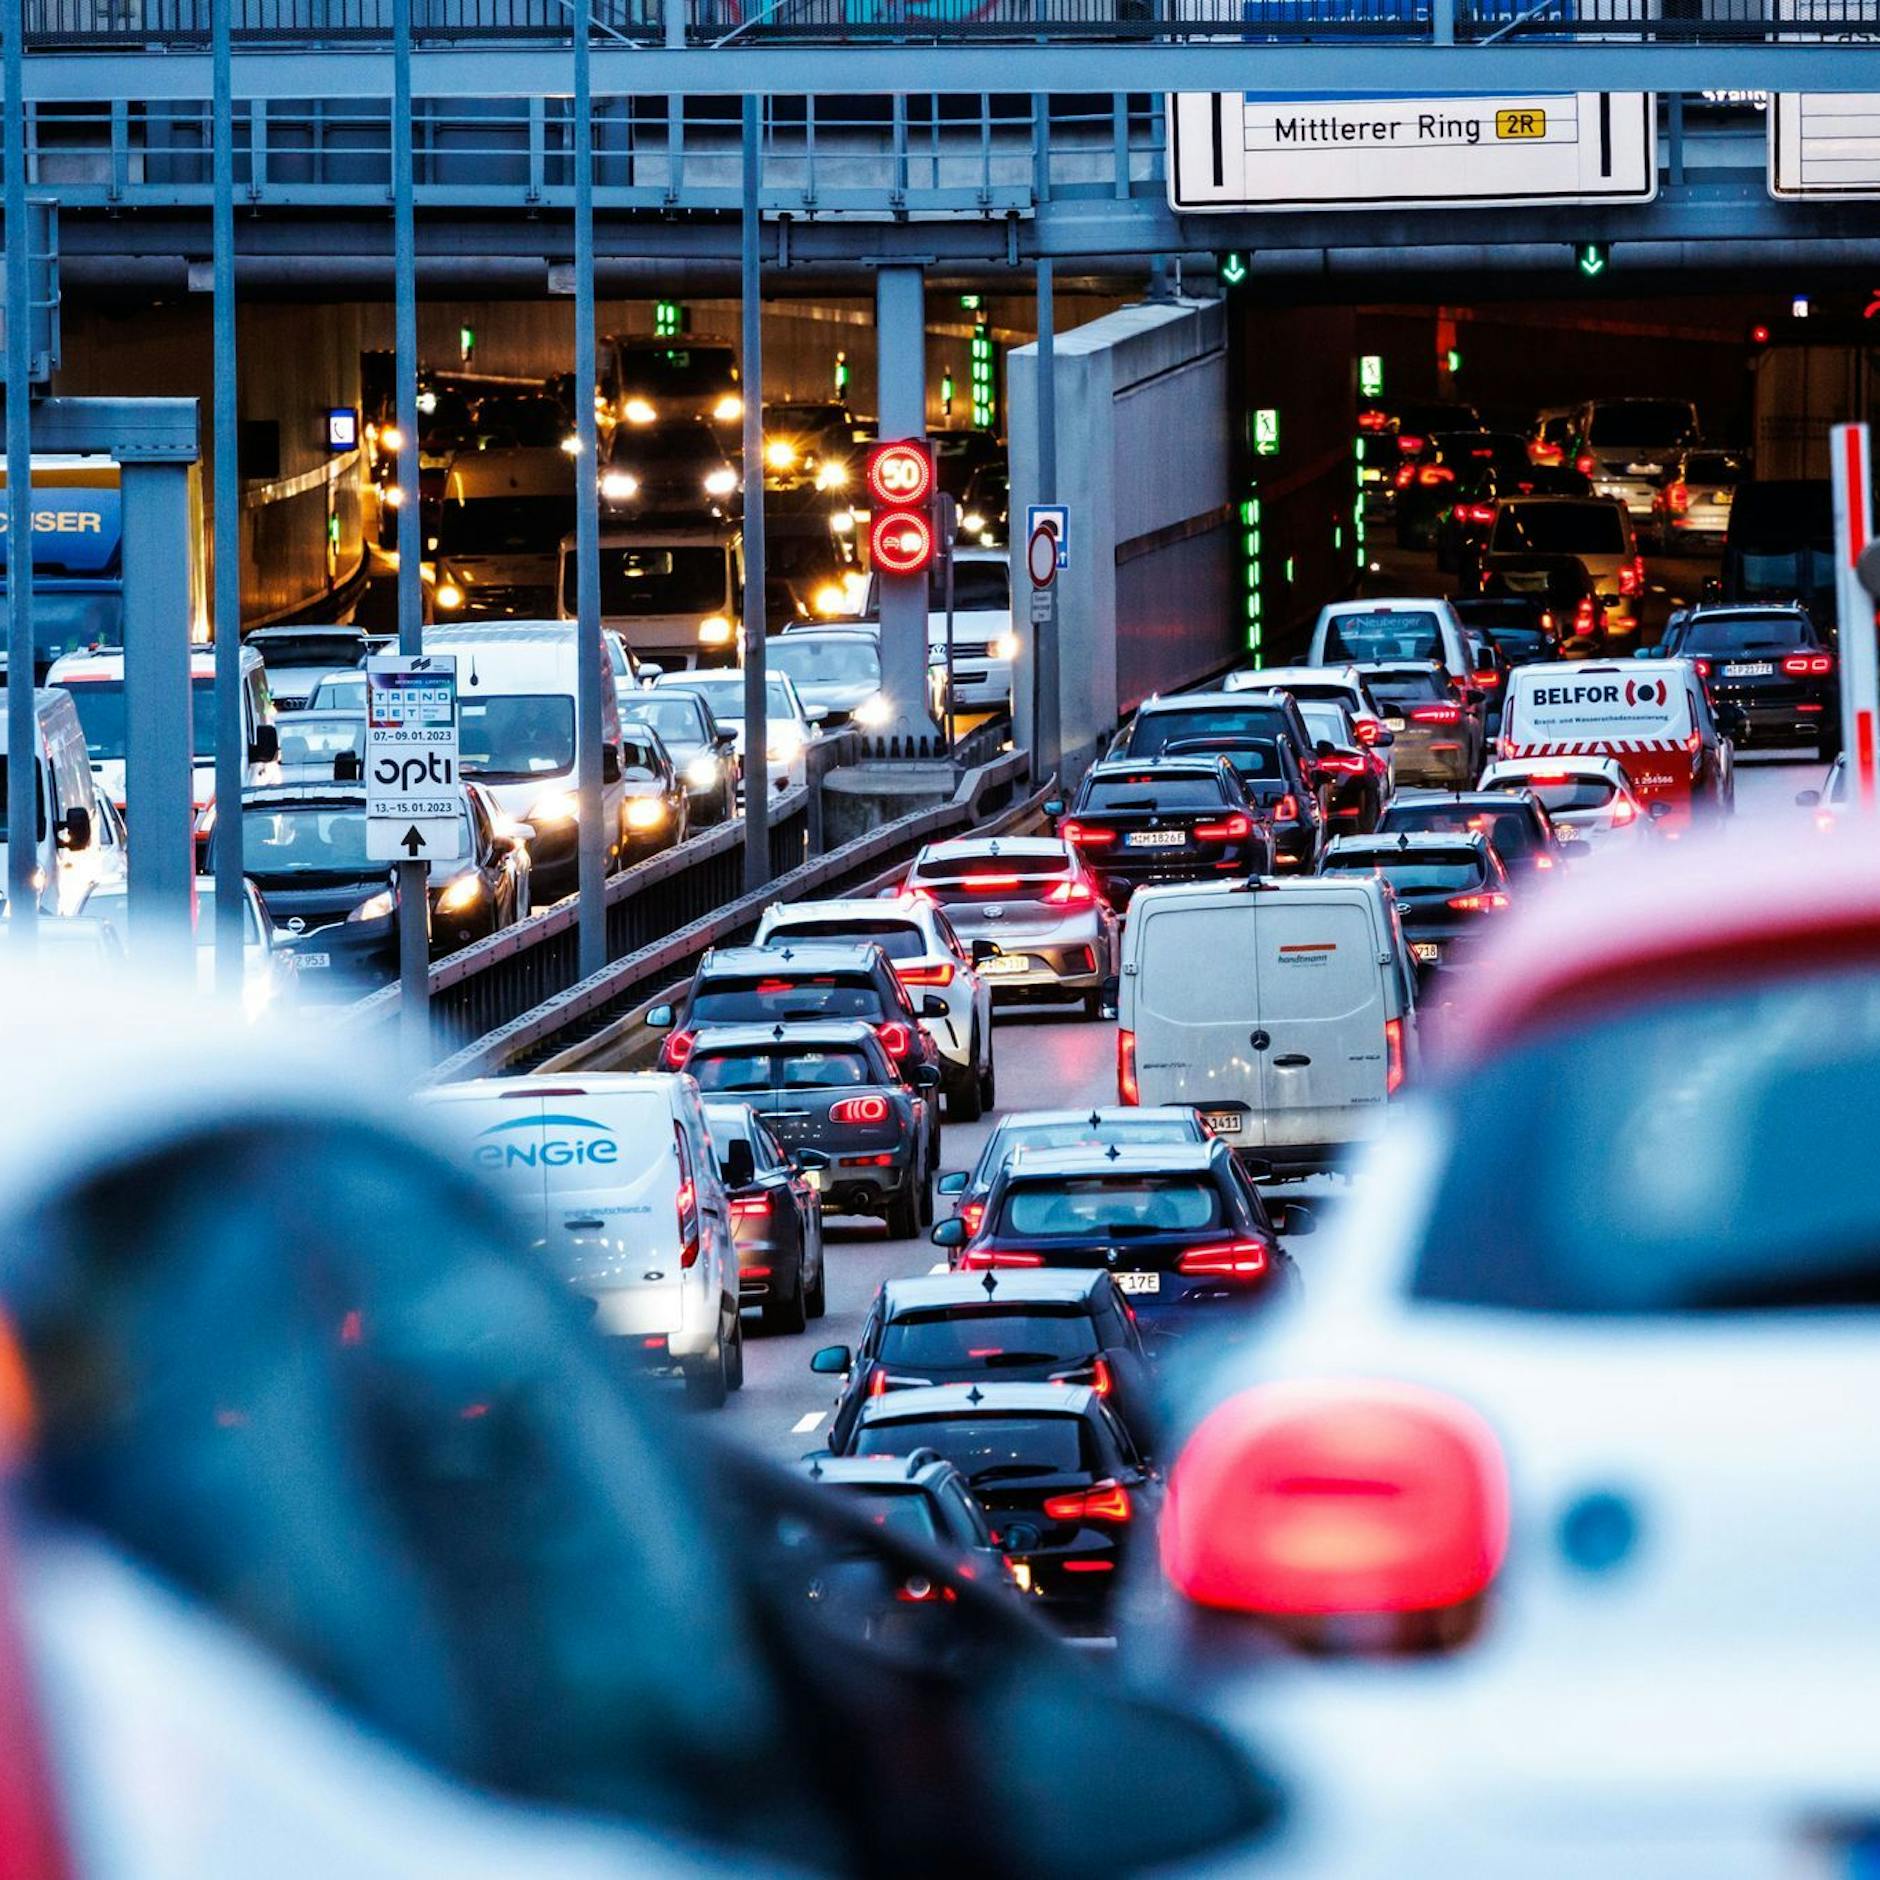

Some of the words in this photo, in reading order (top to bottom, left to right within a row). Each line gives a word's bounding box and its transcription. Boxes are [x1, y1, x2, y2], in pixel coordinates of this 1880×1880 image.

[1275, 117, 1402, 142] Mittlerer
[1418, 114, 1480, 144] Ring
[1507, 114, 1535, 134] 2R
[881, 458, 920, 489] 50
[376, 692, 448, 702] TREND
[1533, 686, 1619, 706] BELFOR
[375, 708, 417, 718] SET
[374, 751, 452, 791] opti
